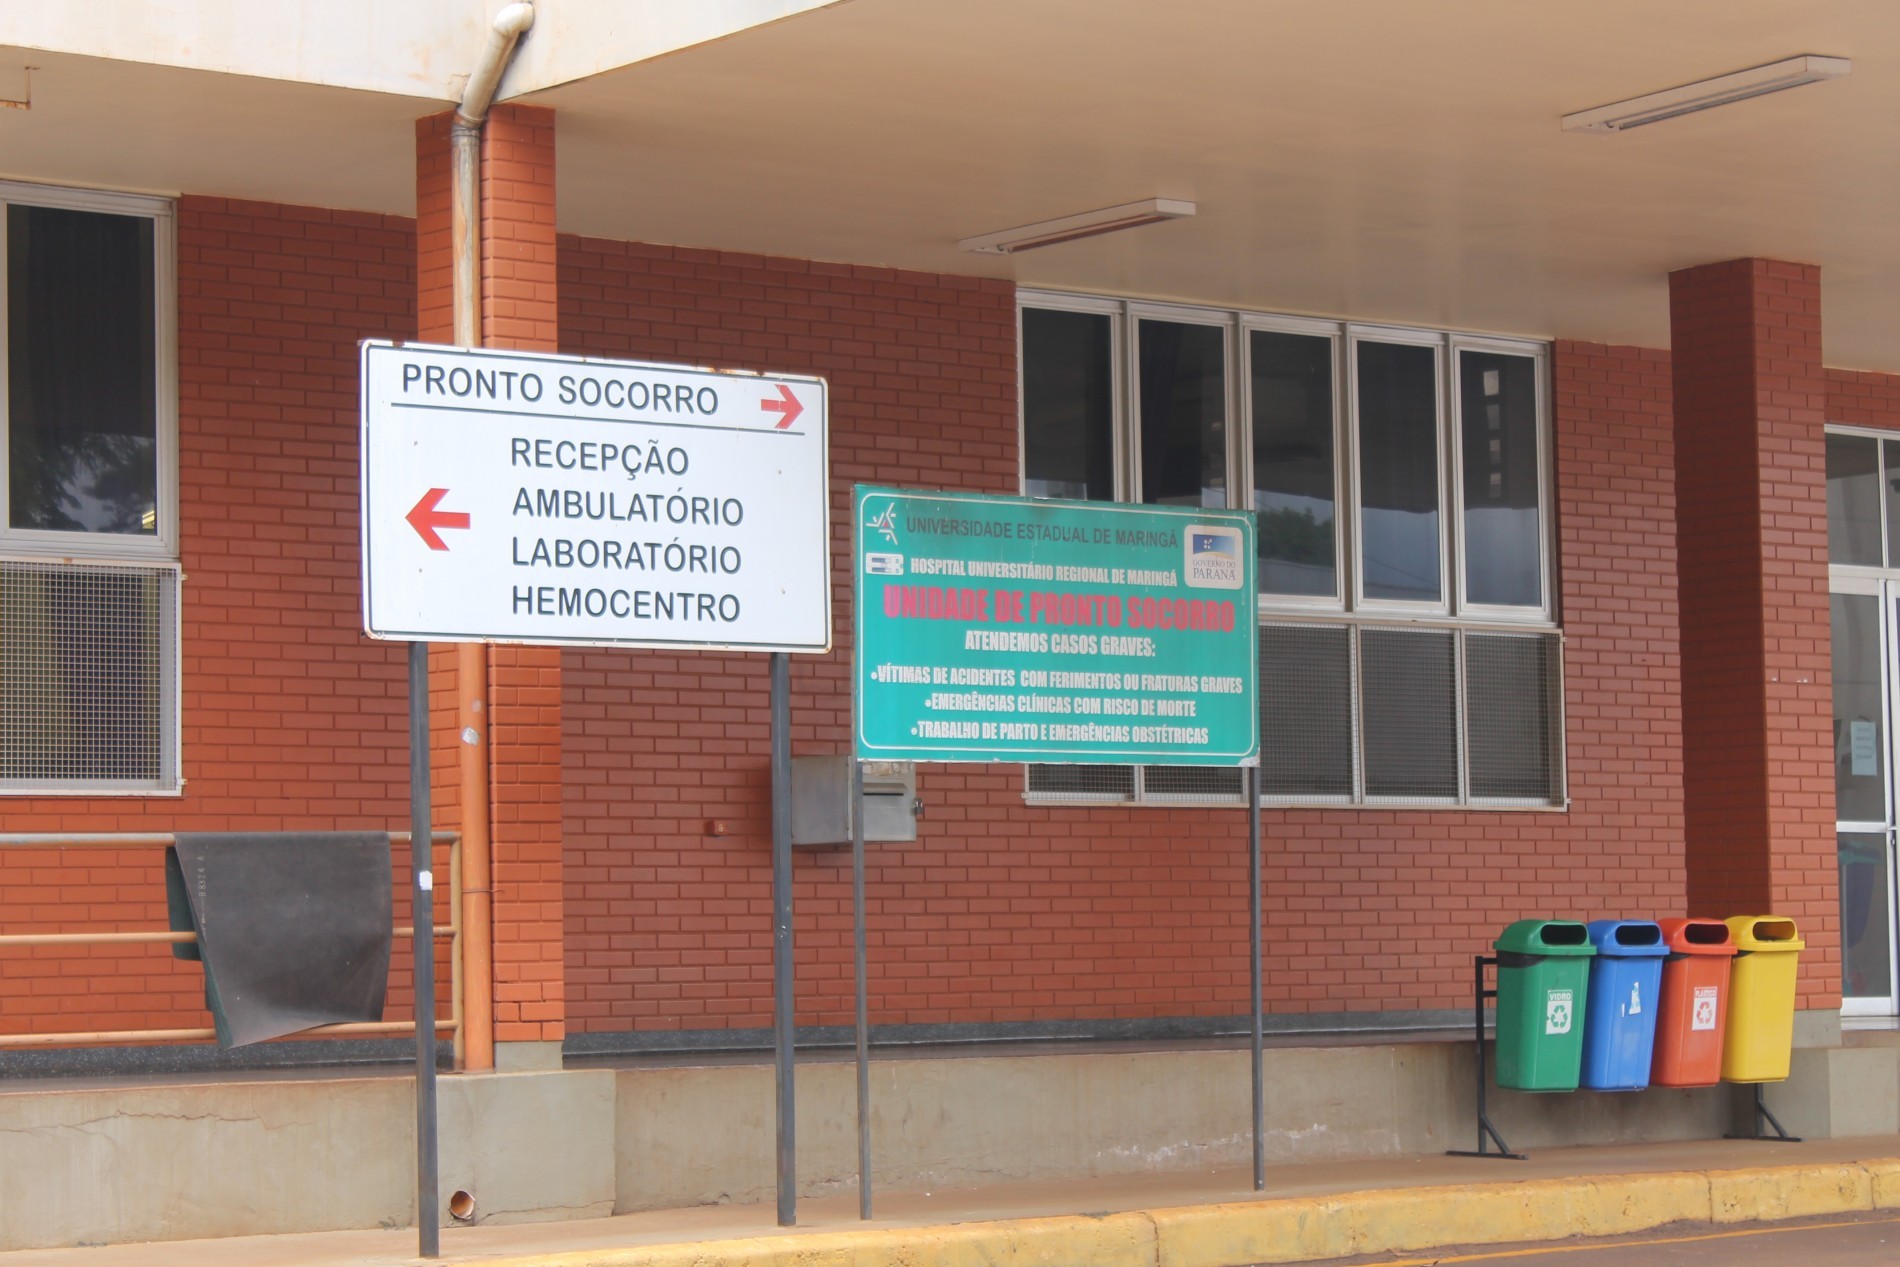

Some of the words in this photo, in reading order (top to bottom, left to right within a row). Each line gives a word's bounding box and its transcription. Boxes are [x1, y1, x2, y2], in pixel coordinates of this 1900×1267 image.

[402, 363, 543, 402] PRONTO
[558, 375, 718, 415] SOCORRO
[511, 437, 689, 480] RECEPÇÃO
[512, 487, 744, 526] AMBULATÓRIO
[906, 517, 1013, 539] UNIVERSIDADE
[1017, 523, 1090, 544] ESTADUAL
[1093, 527, 1111, 545] DE
[1116, 529, 1178, 548] MARINGÁ
[512, 536, 742, 574] LABORATÓRIO
[911, 557, 966, 576] HOSPITAL
[968, 561, 1053, 581] UNIVERSITÁRIO
[1056, 565, 1109, 583] REGIONAL
[1112, 568, 1125, 584] DE
[1127, 569, 1178, 587] MARINGÁ
[1193, 568, 1236, 580] PARANÁ
[512, 585, 741, 622] HEMOCENTRO
[883, 584, 989, 622] UNIDADE
[994, 590, 1025, 623] DE
[1029, 592, 1122, 628] PRONTO
[1127, 596, 1235, 632] SOCORRO
[965, 630, 1048, 653] ATENDEMOS
[1051, 633, 1098, 655] CASOS
[1101, 636, 1156, 657] GRAVES:
[877, 663, 931, 684] VÍTIMAS
[933, 667, 948, 685] DE
[951, 667, 1015, 687] ACIDENTES
[1020, 670, 1047, 688] COM
[1050, 672, 1121, 690] FERIMENTOS
[1124, 674, 1139, 690] OU
[1141, 675, 1198, 692] FRATURAS
[1200, 677, 1243, 694] GRAVES
[931, 691, 1015, 712] EMERGÊNCIAS
[1017, 693, 1071, 714] CLÍNICAS
[1074, 698, 1101, 715] COM
[1104, 699, 1138, 716] RISCO
[1141, 700, 1155, 716] DE
[1157, 700, 1196, 717] MORTE
[917, 721, 980, 739] TRABALHO
[982, 723, 997, 740] DE
[1000, 723, 1038, 741] PARTO
[1040, 725, 1047, 740] E
[1050, 722, 1129, 743] EMERGÊNCIAS
[1132, 724, 1209, 744] OBSTÉTRICAS
[1550, 992, 1572, 1001] VIDRO
